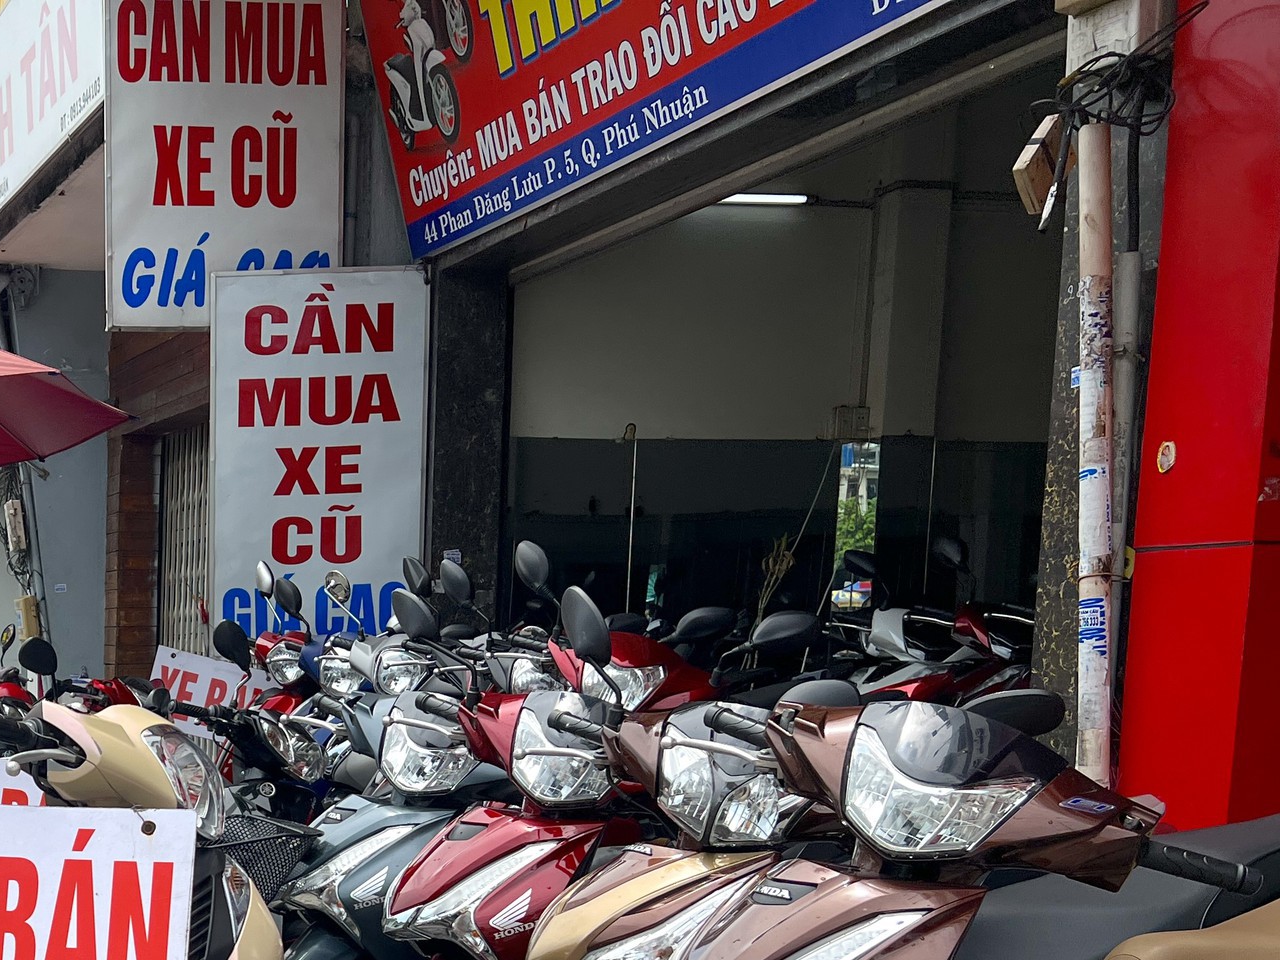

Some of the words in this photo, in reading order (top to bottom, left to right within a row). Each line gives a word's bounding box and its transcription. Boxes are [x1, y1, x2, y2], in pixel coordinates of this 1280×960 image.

[19, 0, 78, 135] TÂN
[224, 1, 328, 86] MUA
[152, 125, 216, 207] XE
[230, 111, 298, 209] CŨ
[409, 147, 476, 207] Chuyên:
[474, 111, 523, 171] MUA
[522, 78, 572, 145] BÁN
[570, 40, 639, 116] TRAO
[424, 221, 438, 244] 44
[438, 208, 473, 238] Phan
[474, 188, 511, 220] Đăng
[511, 173, 542, 201] Lưu
[564, 151, 581, 177] 5,
[581, 137, 602, 168] Q.
[602, 113, 641, 155] Phú
[641, 85, 710, 135] Nhuận
[122, 232, 210, 308] GIÁ
[244, 283, 395, 356] CẦN
[237, 373, 401, 428] MUA
[273, 445, 363, 496] XE
[271, 504, 363, 565] CŨ
[493, 920, 538, 940] HOND
